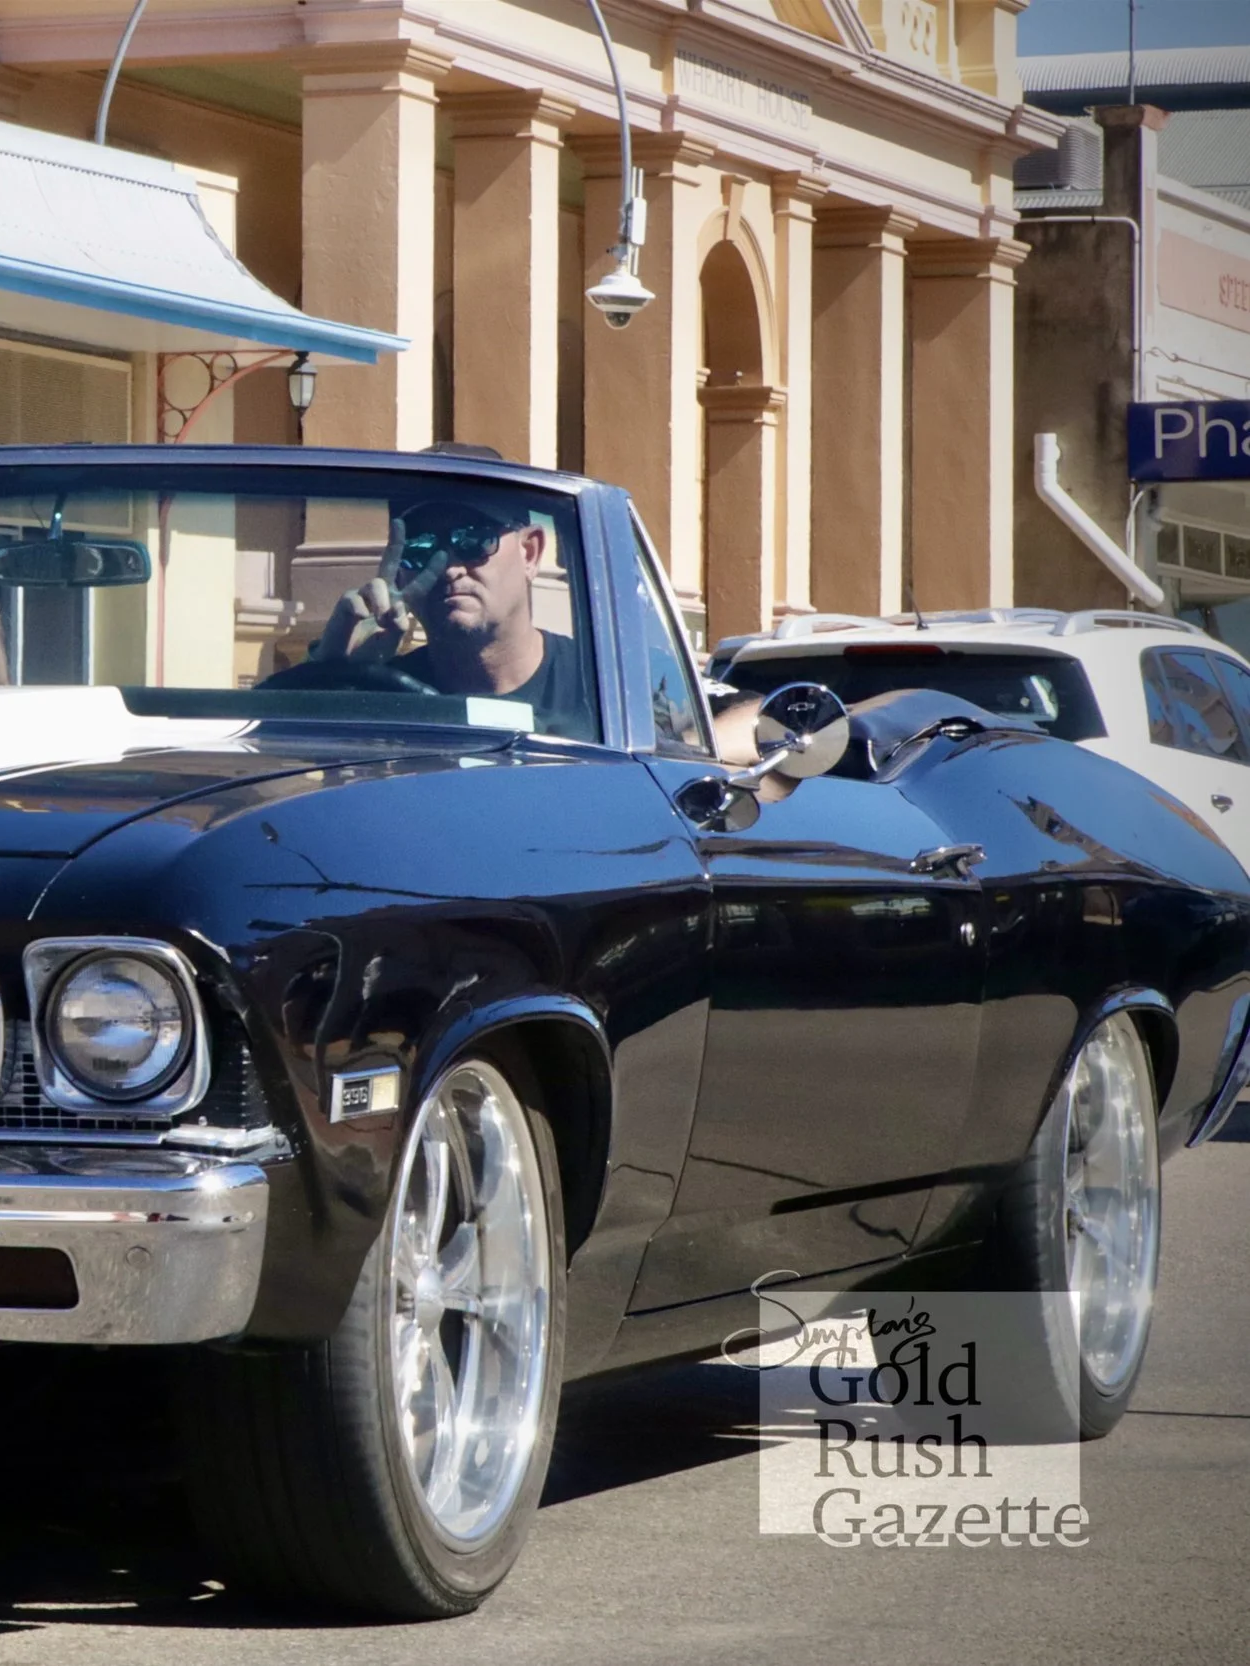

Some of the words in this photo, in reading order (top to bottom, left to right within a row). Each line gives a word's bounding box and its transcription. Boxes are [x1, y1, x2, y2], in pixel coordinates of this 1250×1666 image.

[677, 50, 748, 109] WHERRY
[756, 78, 810, 131] HOUSE
[1154, 405, 1250, 459] Ph
